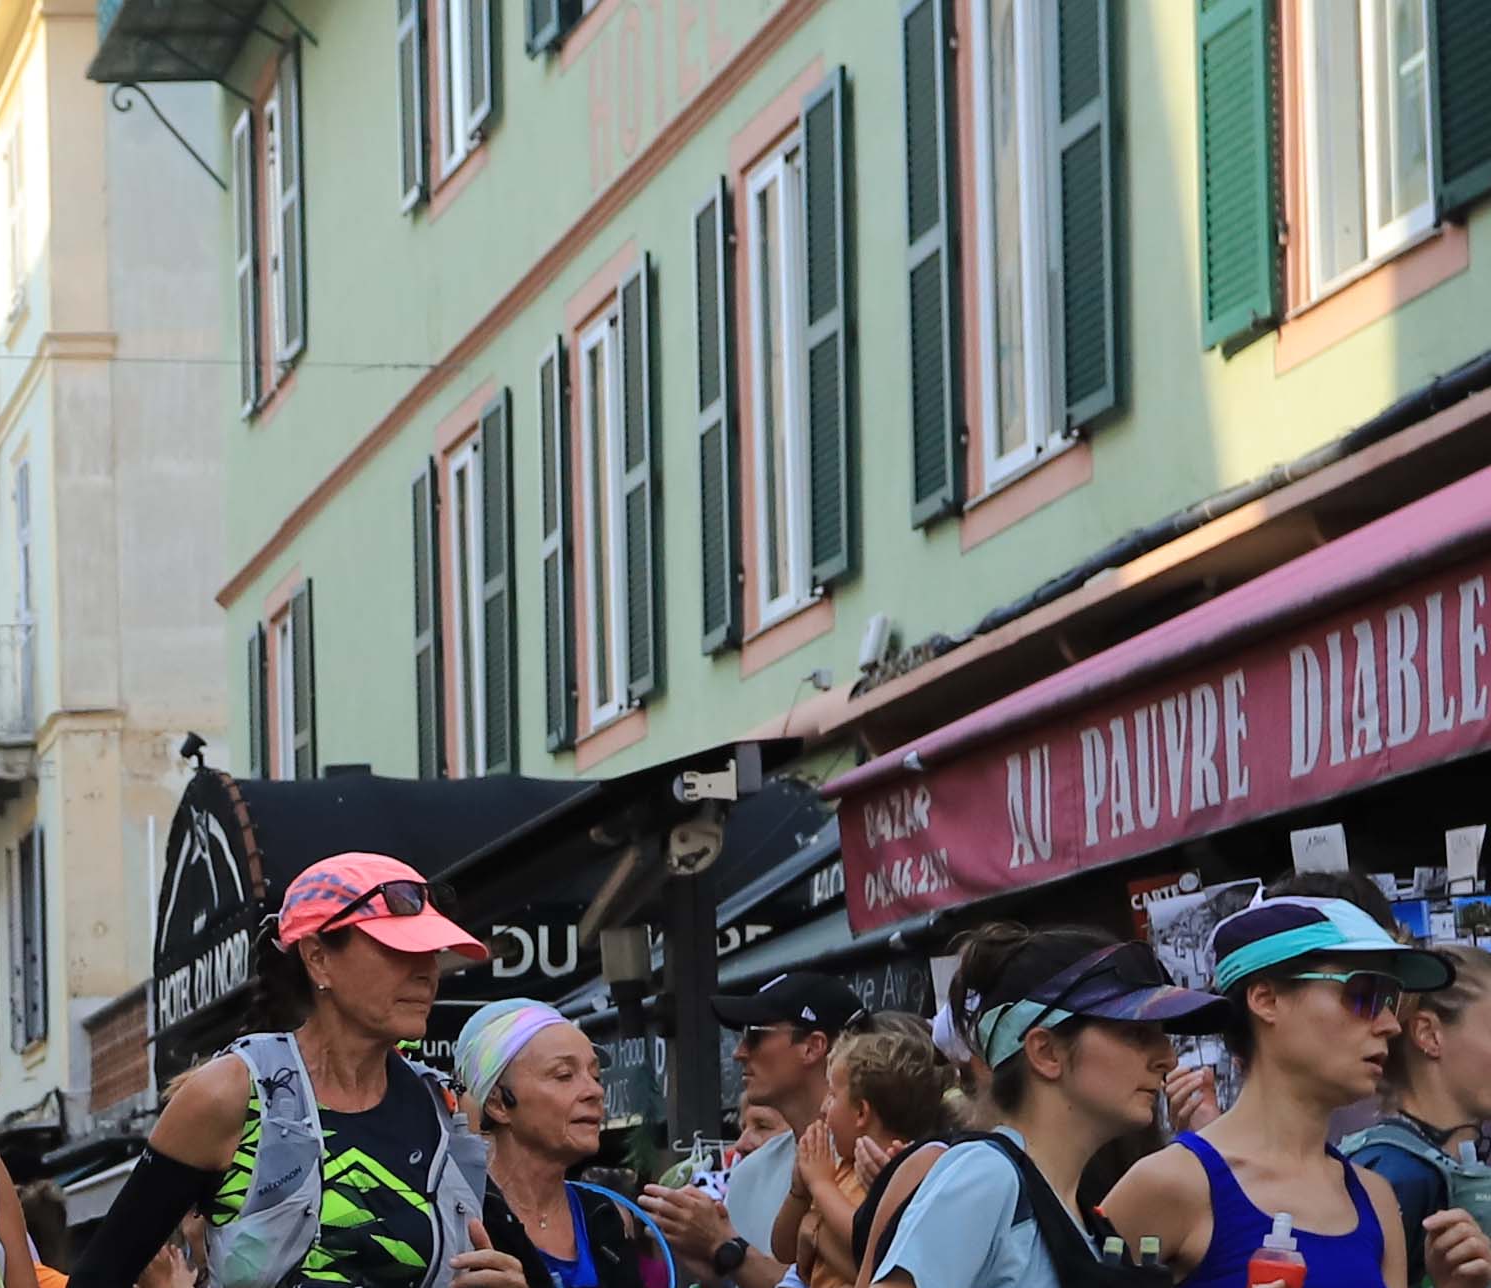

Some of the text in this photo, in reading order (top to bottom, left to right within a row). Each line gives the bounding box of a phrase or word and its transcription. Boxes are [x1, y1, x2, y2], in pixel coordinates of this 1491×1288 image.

[1006, 575, 1489, 869] AU PAUVRE DIABLE
[159, 964, 194, 1030] HOTEL
[214, 928, 249, 996] NORD
[492, 924, 578, 978] DU
